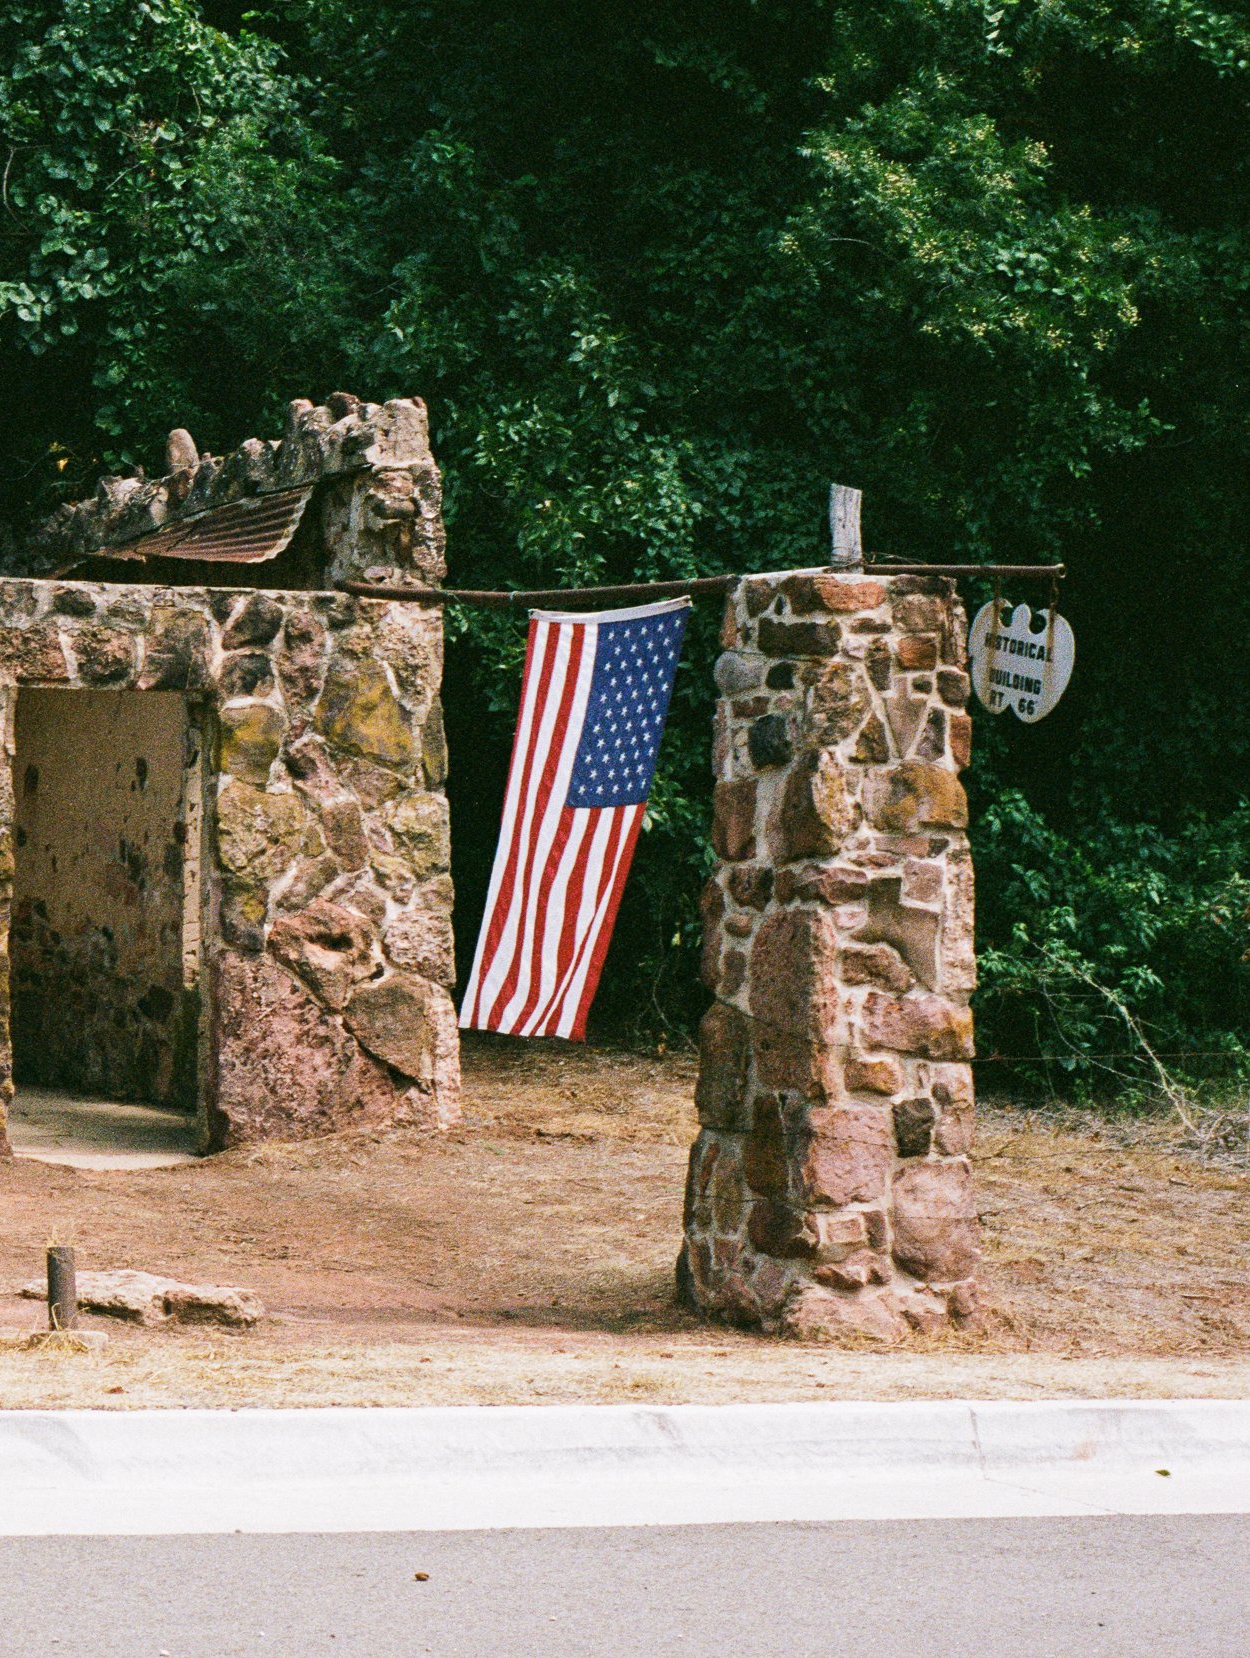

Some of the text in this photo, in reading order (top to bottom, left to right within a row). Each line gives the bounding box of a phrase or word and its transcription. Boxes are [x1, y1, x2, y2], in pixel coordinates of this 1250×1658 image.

[989, 669, 1042, 695] BUILDING
[990, 690, 1035, 715] RT 66
